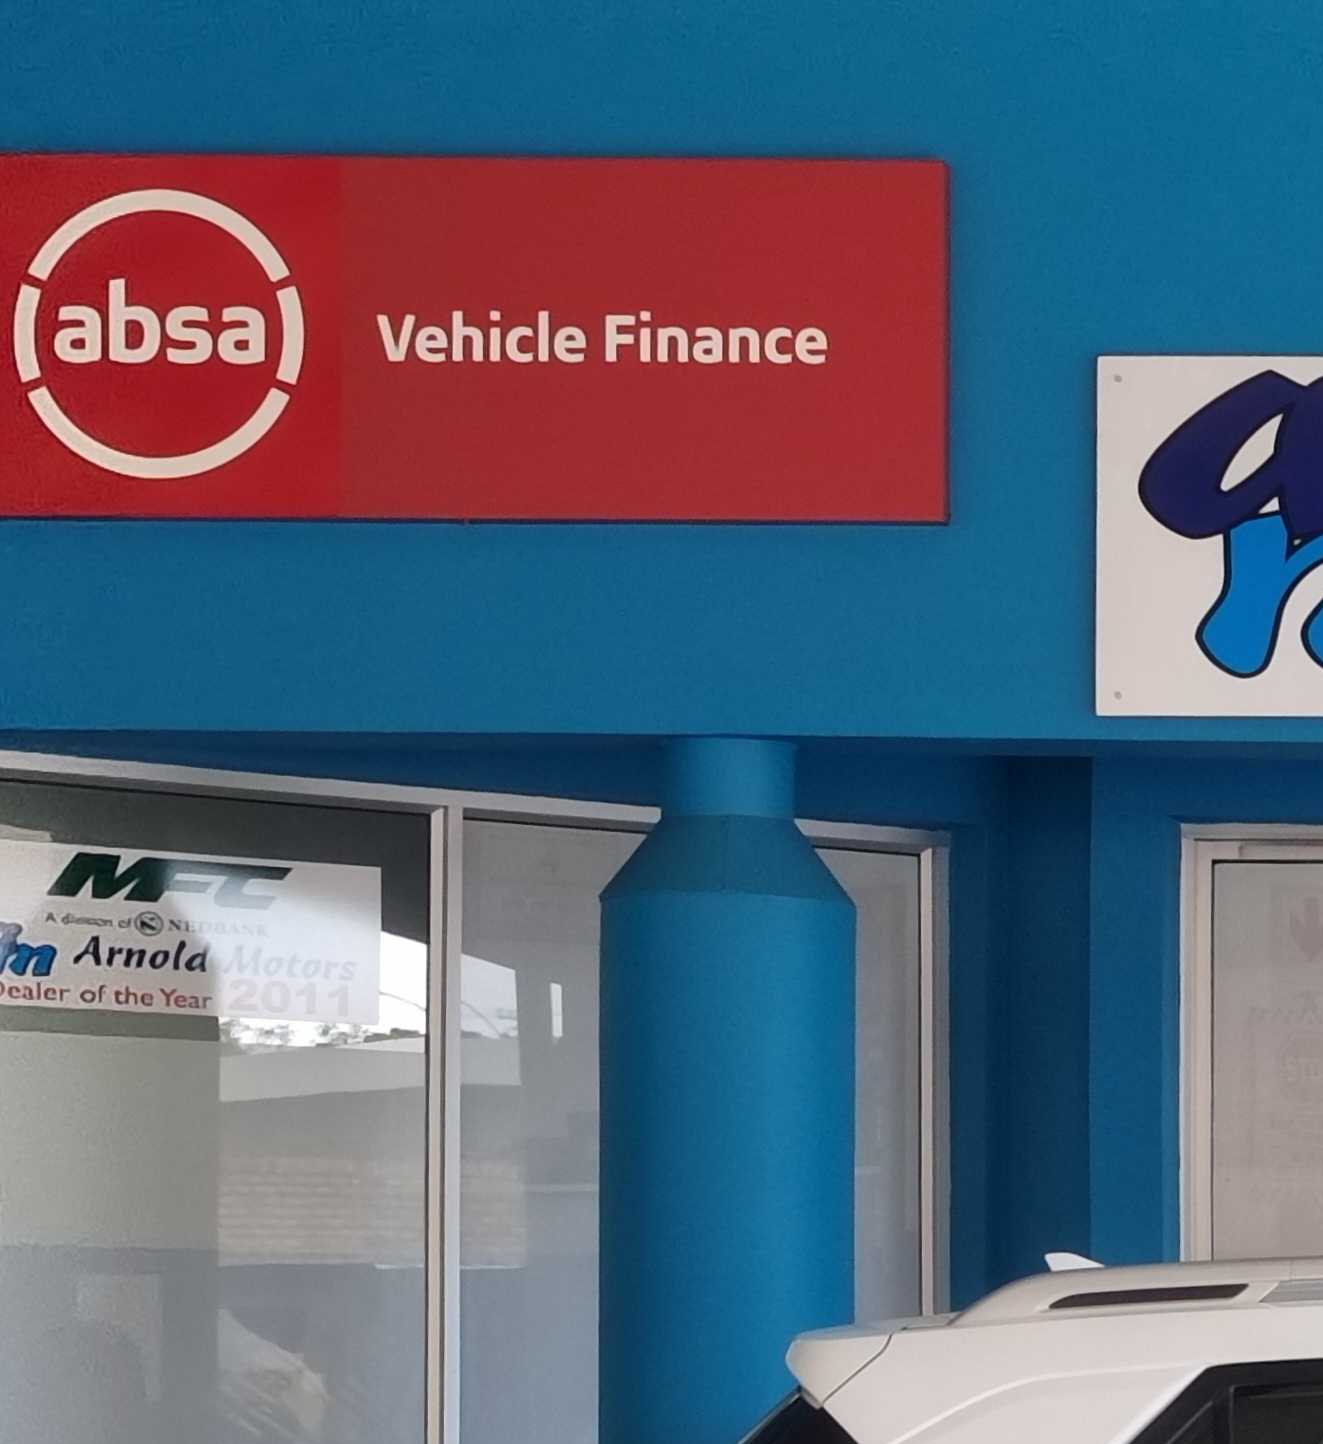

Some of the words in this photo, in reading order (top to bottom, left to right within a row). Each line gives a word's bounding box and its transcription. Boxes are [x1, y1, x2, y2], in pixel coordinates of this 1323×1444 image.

[53, 278, 267, 364] absa
[376, 310, 586, 364] Vehicle
[604, 310, 828, 364] Finance
[46, 852, 294, 910] MFC
[73, 935, 211, 973] Arnold
[222, 945, 357, 981] Motors
[79, 984, 107, 1004] of
[115, 986, 154, 1007] the
[159, 988, 213, 1010] Year
[228, 978, 349, 1017] 2011
